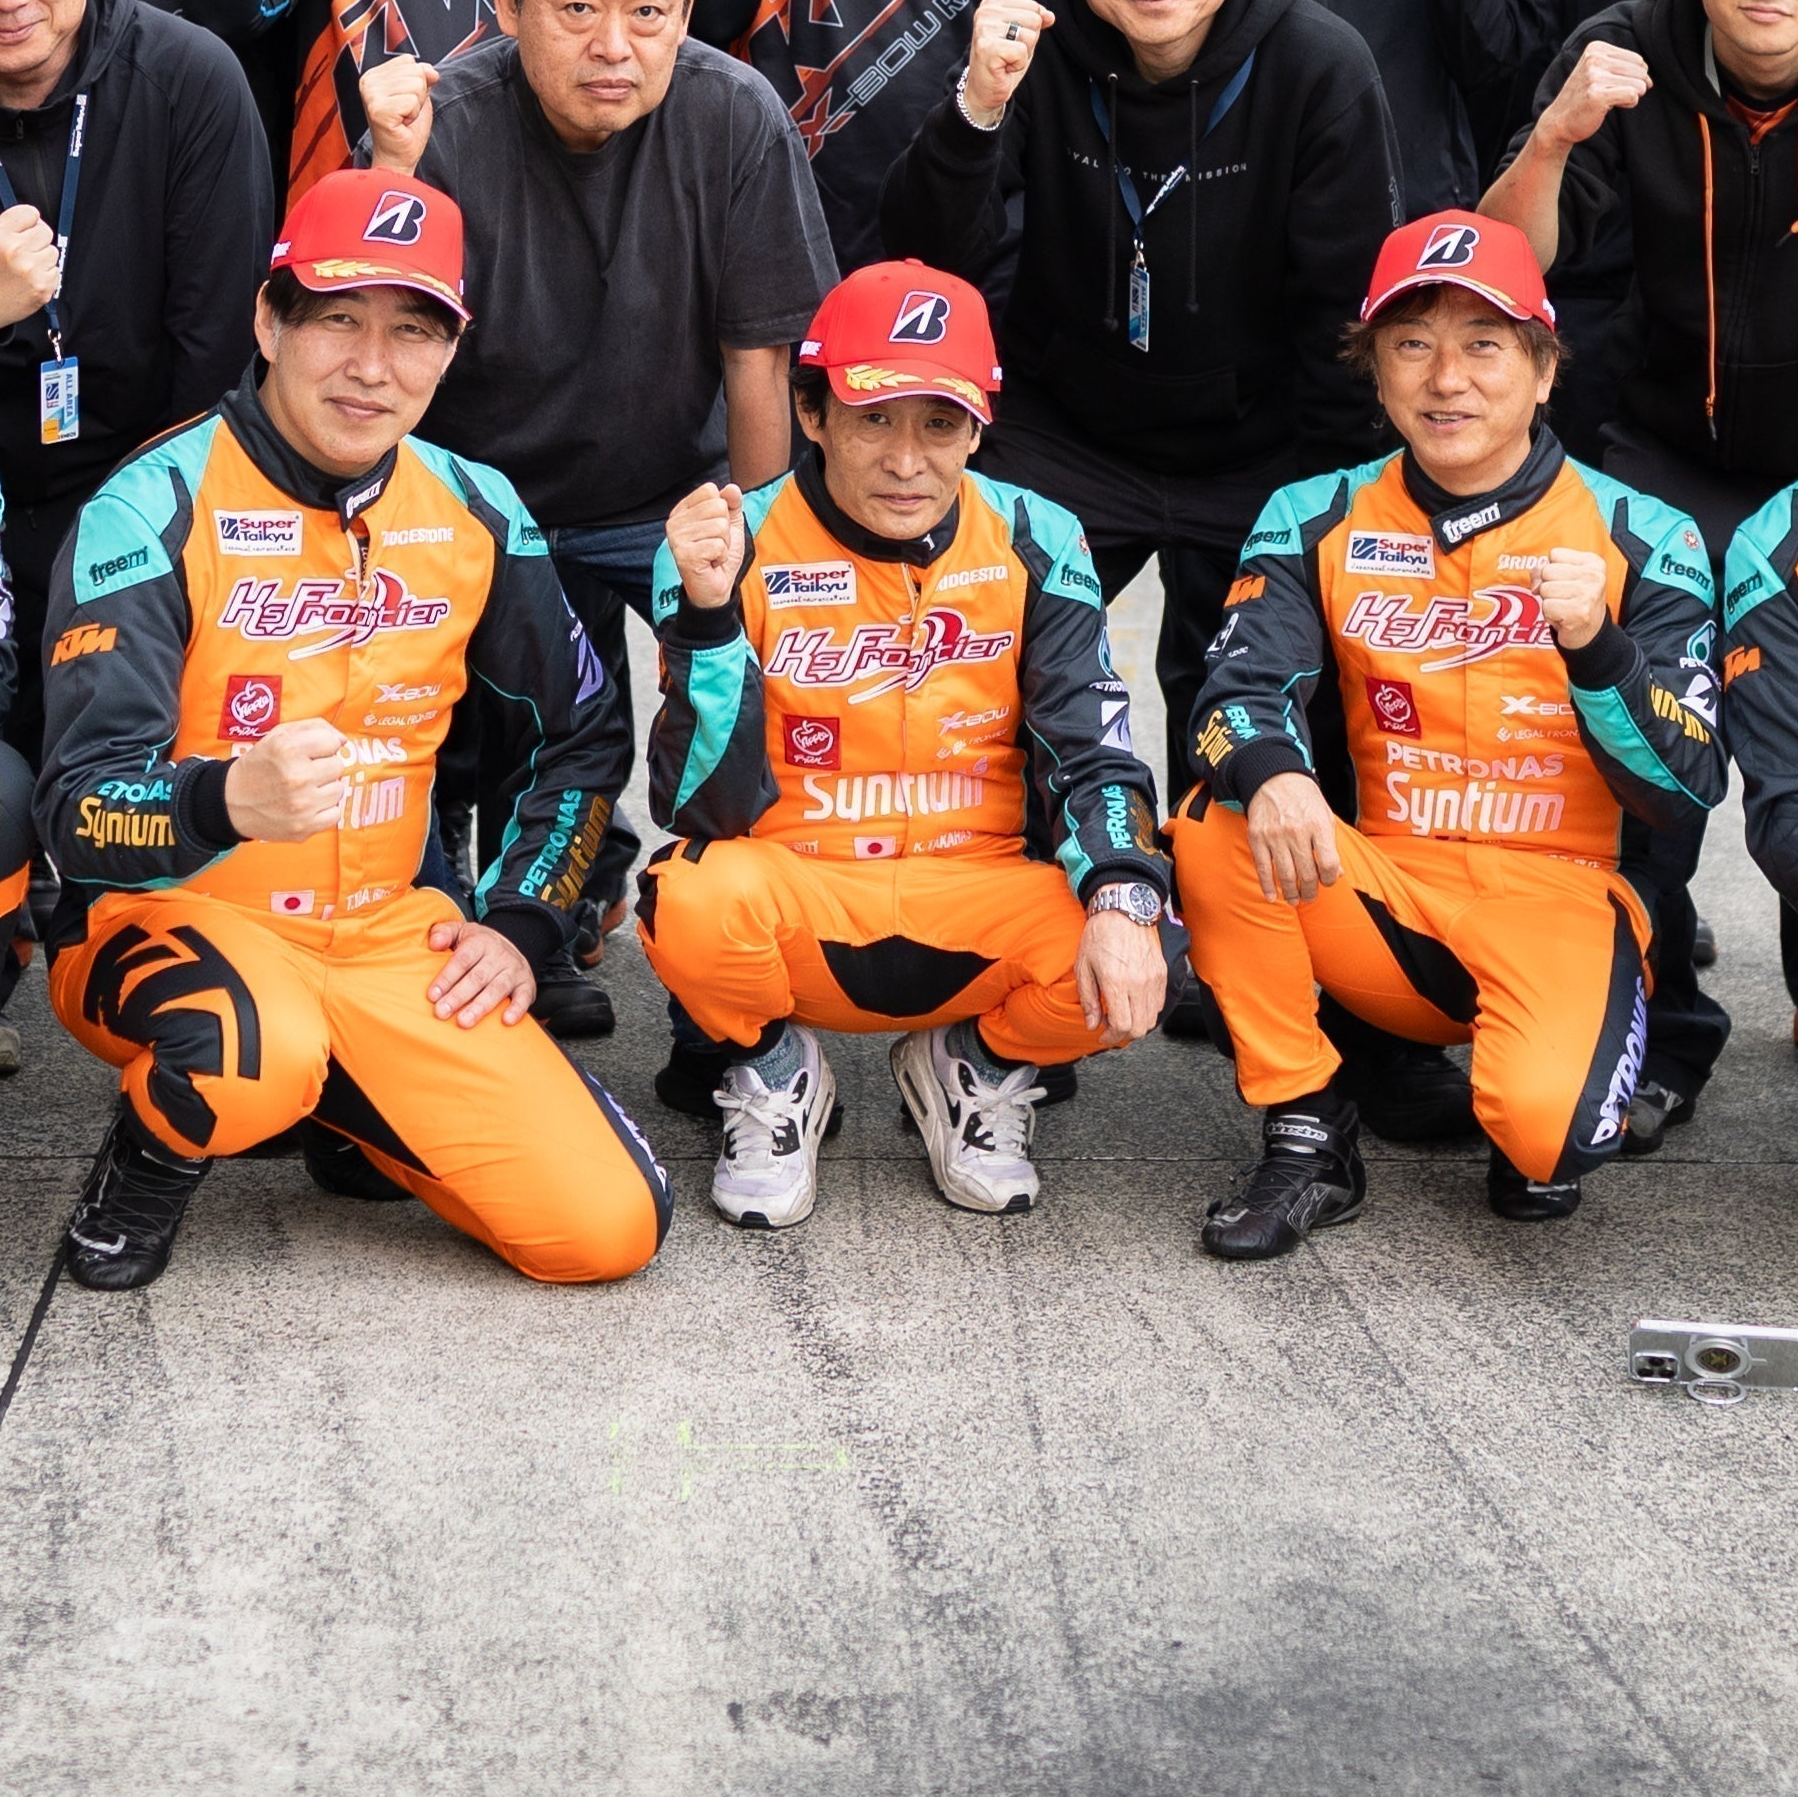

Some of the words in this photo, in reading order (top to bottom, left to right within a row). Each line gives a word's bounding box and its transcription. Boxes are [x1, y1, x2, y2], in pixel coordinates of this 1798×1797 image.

[239, 529, 295, 544] Taikyu
[240, 517, 297, 535] Super
[1442, 502, 1501, 544] freem
[1377, 550, 1428, 566] Taikyu
[1378, 538, 1428, 554] Super
[89, 546, 149, 587] freem
[791, 568, 850, 584] Super
[1061, 563, 1101, 599] freem
[1660, 552, 1712, 591] freem
[658, 584, 681, 608] fre
[790, 579, 849, 596] Taikyu
[51, 622, 119, 668] KTM
[1514, 728, 1545, 741] LEGAL
[336, 736, 408, 768] ONAS
[1385, 740, 1566, 781] PETRONAS
[337, 770, 406, 830] tium
[1385, 770, 1566, 838] Syntium
[518, 788, 583, 898] PETRONAS
